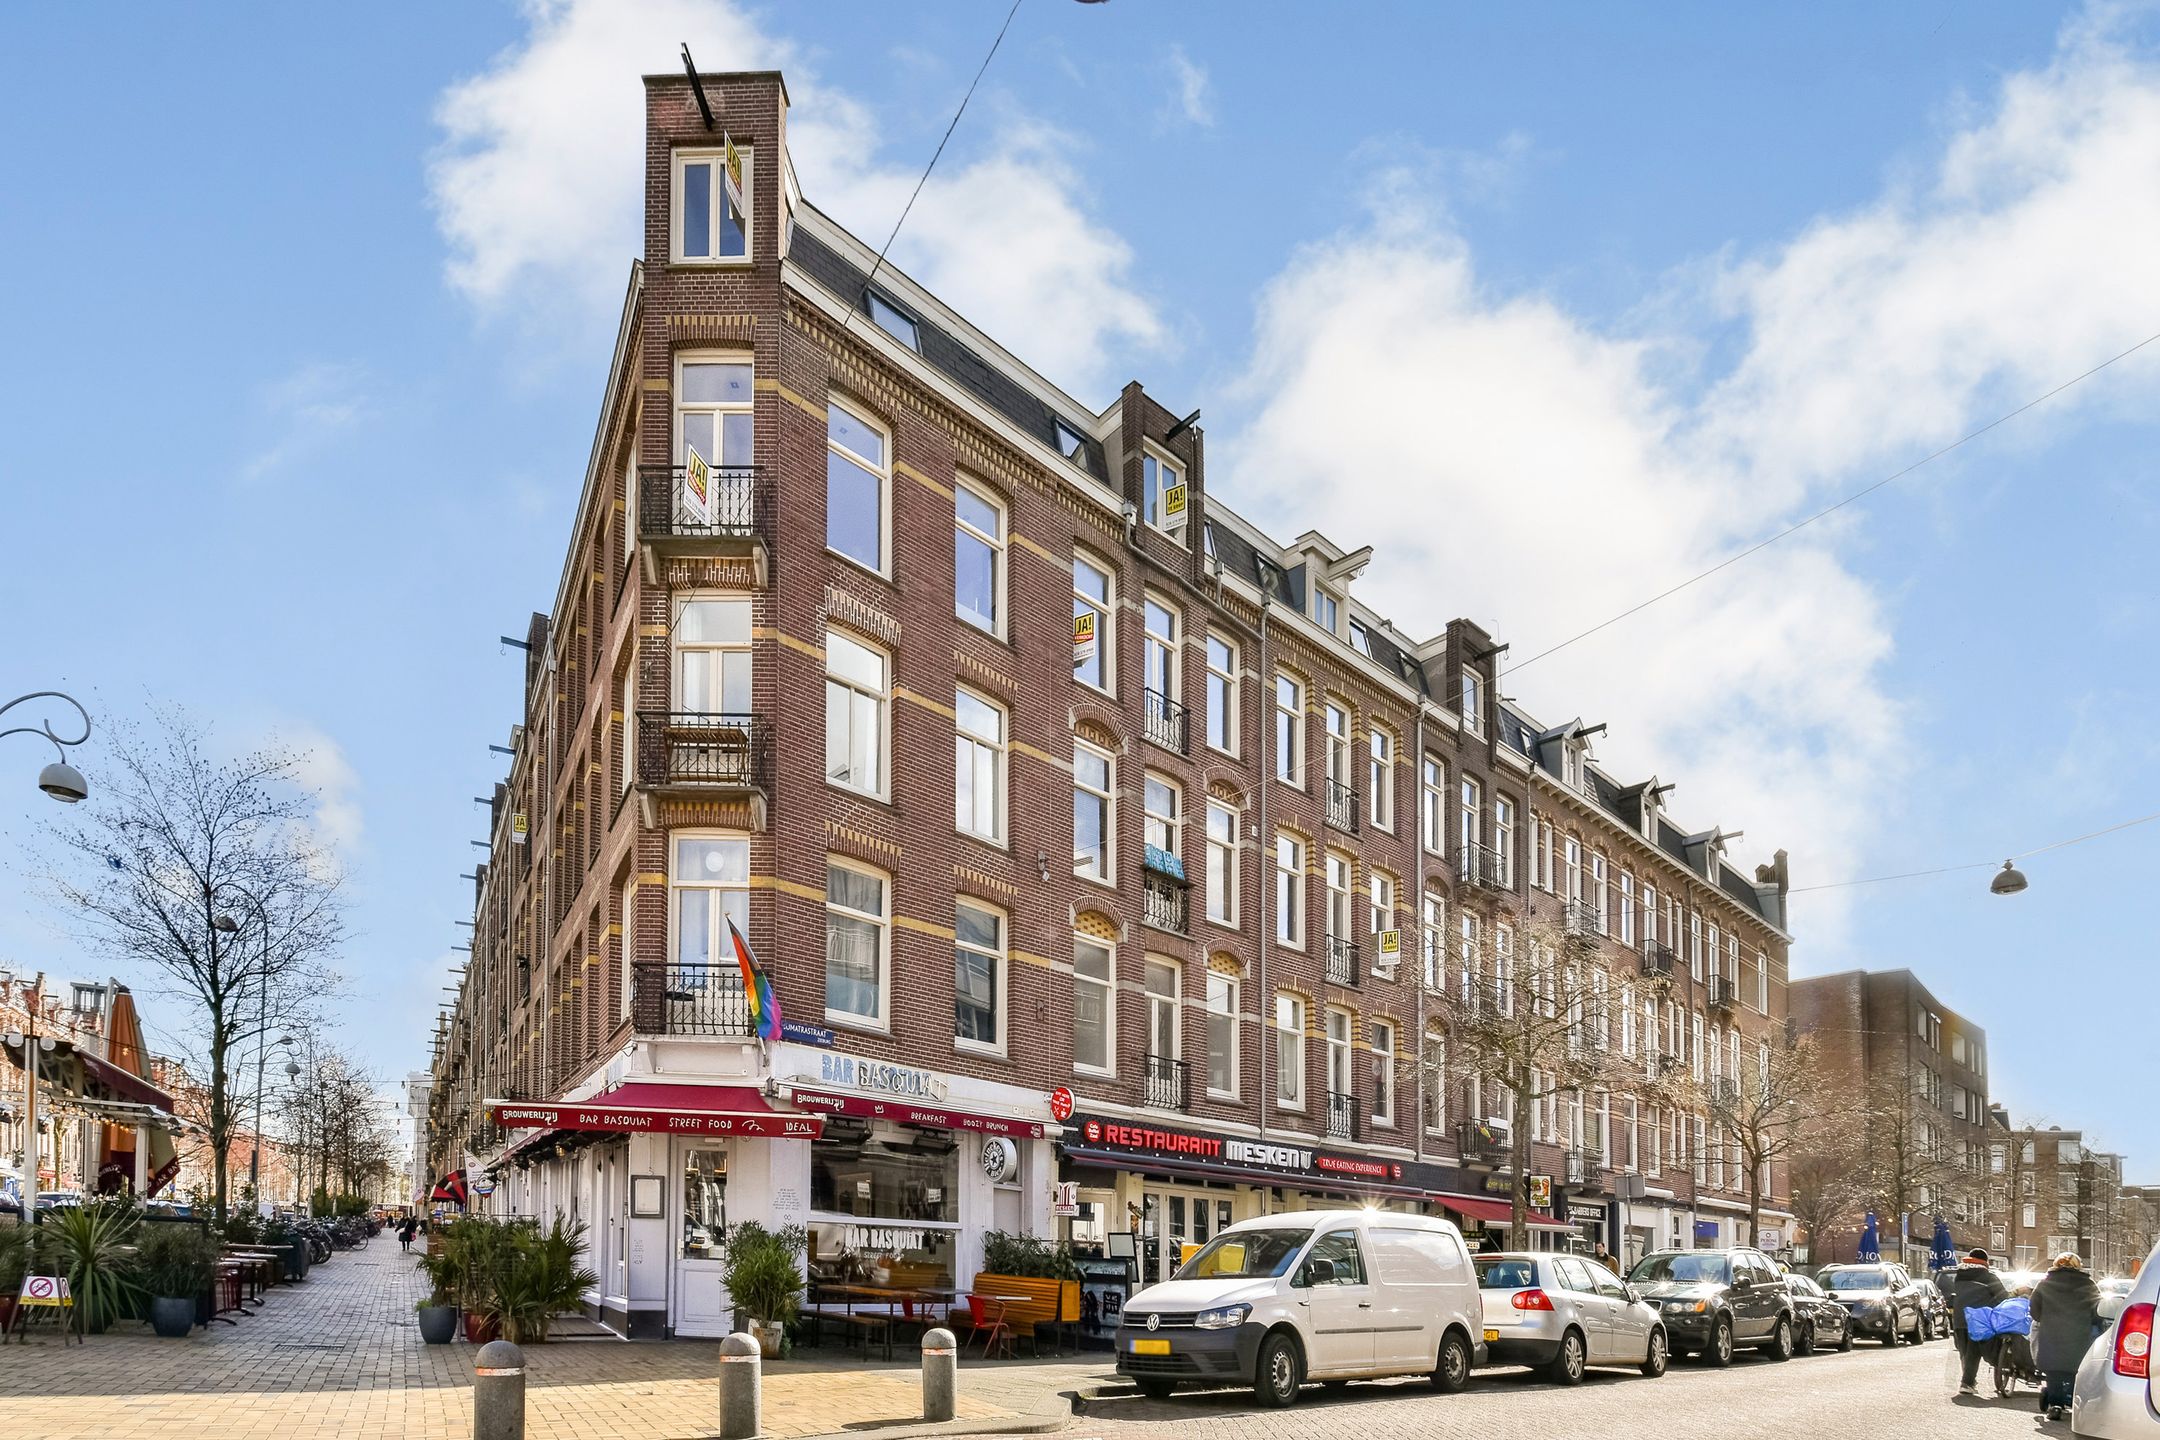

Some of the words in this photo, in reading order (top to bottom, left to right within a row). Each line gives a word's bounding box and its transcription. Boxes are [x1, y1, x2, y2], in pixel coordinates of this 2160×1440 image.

[693, 457, 706, 487] JA!
[1168, 488, 1183, 505] JA!
[1077, 616, 1091, 634] JA!
[1384, 933, 1397, 945] JA!
[822, 1054, 855, 1084] BAR
[858, 1060, 949, 1101] BASQUIAT
[797, 1093, 834, 1105] BROUWERIJ
[502, 1110, 545, 1120] BROUWERIJ
[579, 1114, 598, 1125] BAR
[604, 1115, 653, 1127] BASQUIAT
[669, 1117, 702, 1129] STREET
[708, 1119, 732, 1129] FOOD
[785, 1122, 813, 1132] IDEAL
[910, 1111, 947, 1124] BREAKFAST
[963, 1119, 983, 1128] BOOZY
[986, 1121, 1009, 1132] BRUNCH
[1105, 1124, 1222, 1157] RESTAURANT
[1226, 1140, 1301, 1169] MESKEN
[1336, 1161, 1355, 1171] EATING
[1355, 1163, 1382, 1174] EXPERIENCE
[845, 1226, 869, 1248] BAR
[870, 1228, 925, 1250] BASQUIAT
